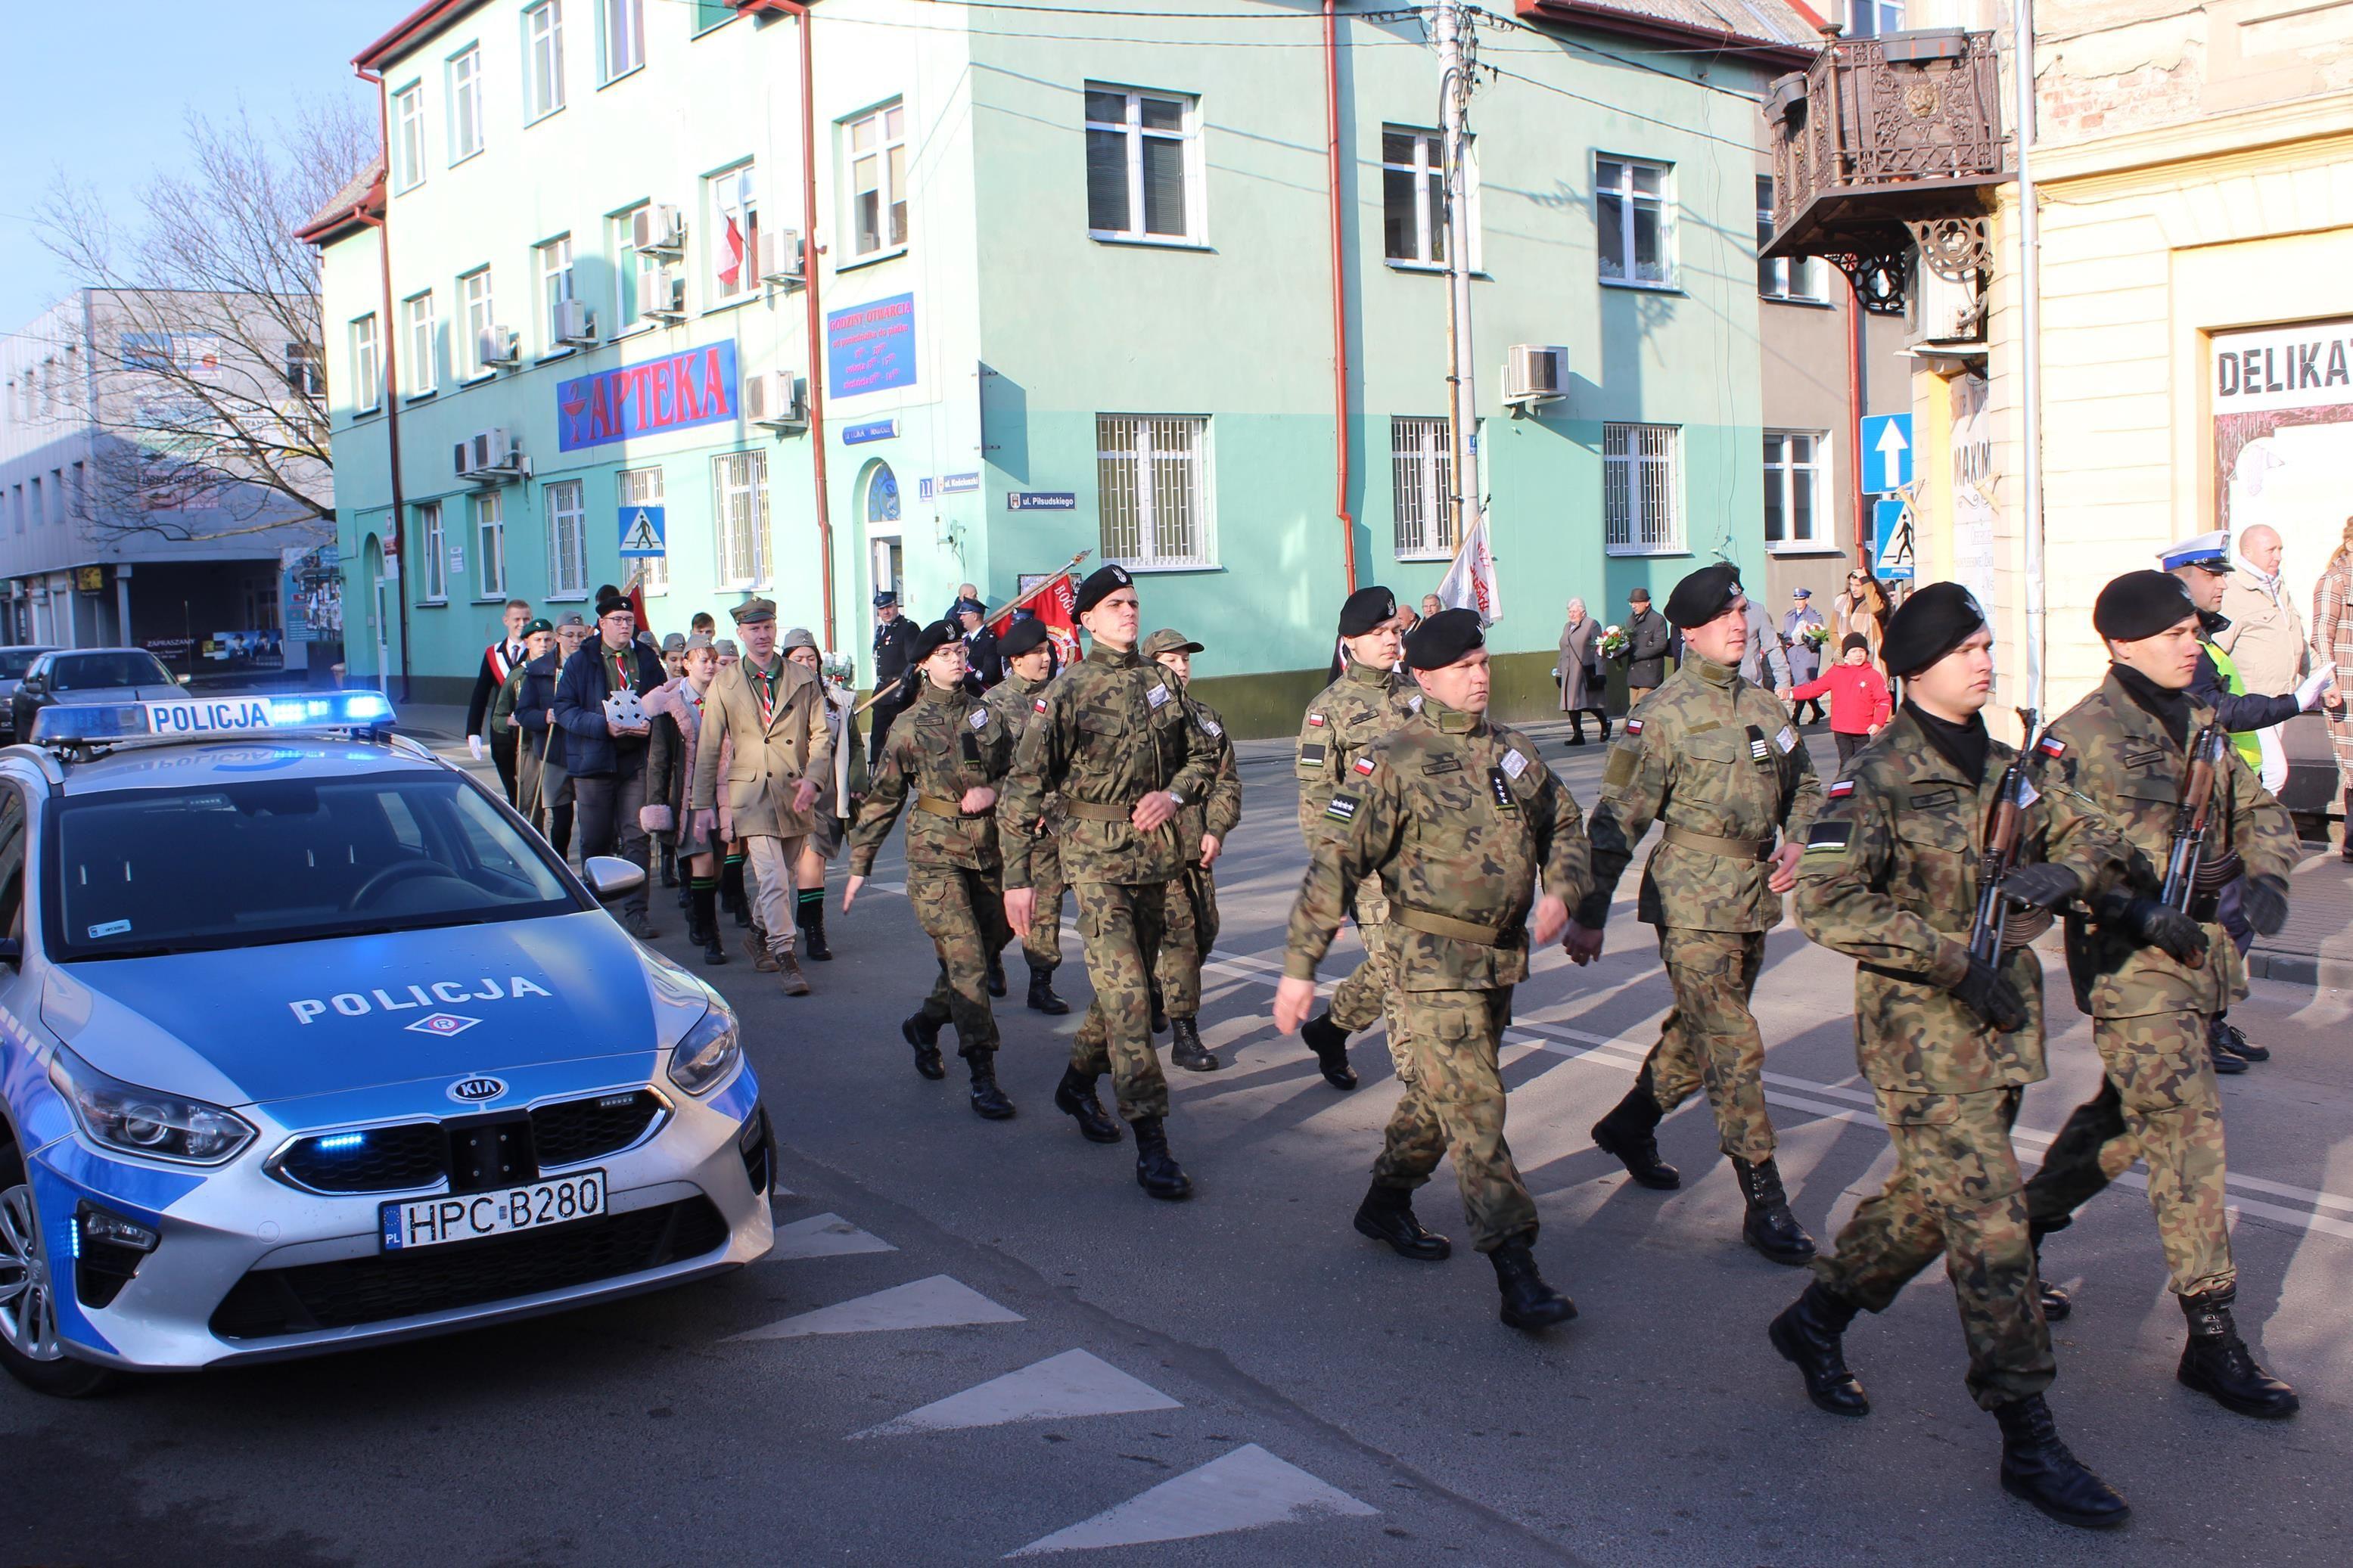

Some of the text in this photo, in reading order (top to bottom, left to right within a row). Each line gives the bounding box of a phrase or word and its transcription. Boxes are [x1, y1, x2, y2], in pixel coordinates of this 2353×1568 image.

[830, 313, 864, 331] GODZINY
[878, 328, 887, 337] do
[2219, 338, 2353, 396] DELIKA
[589, 347, 729, 439] APTEKA
[921, 480, 932, 496] 11
[154, 703, 269, 732] POLICJA
[289, 976, 553, 1024] POLICJA
[437, 1020, 452, 1029] R
[461, 1079, 496, 1096] KIA
[409, 1178, 598, 1244] HPC B280
[386, 1233, 400, 1244] PL
